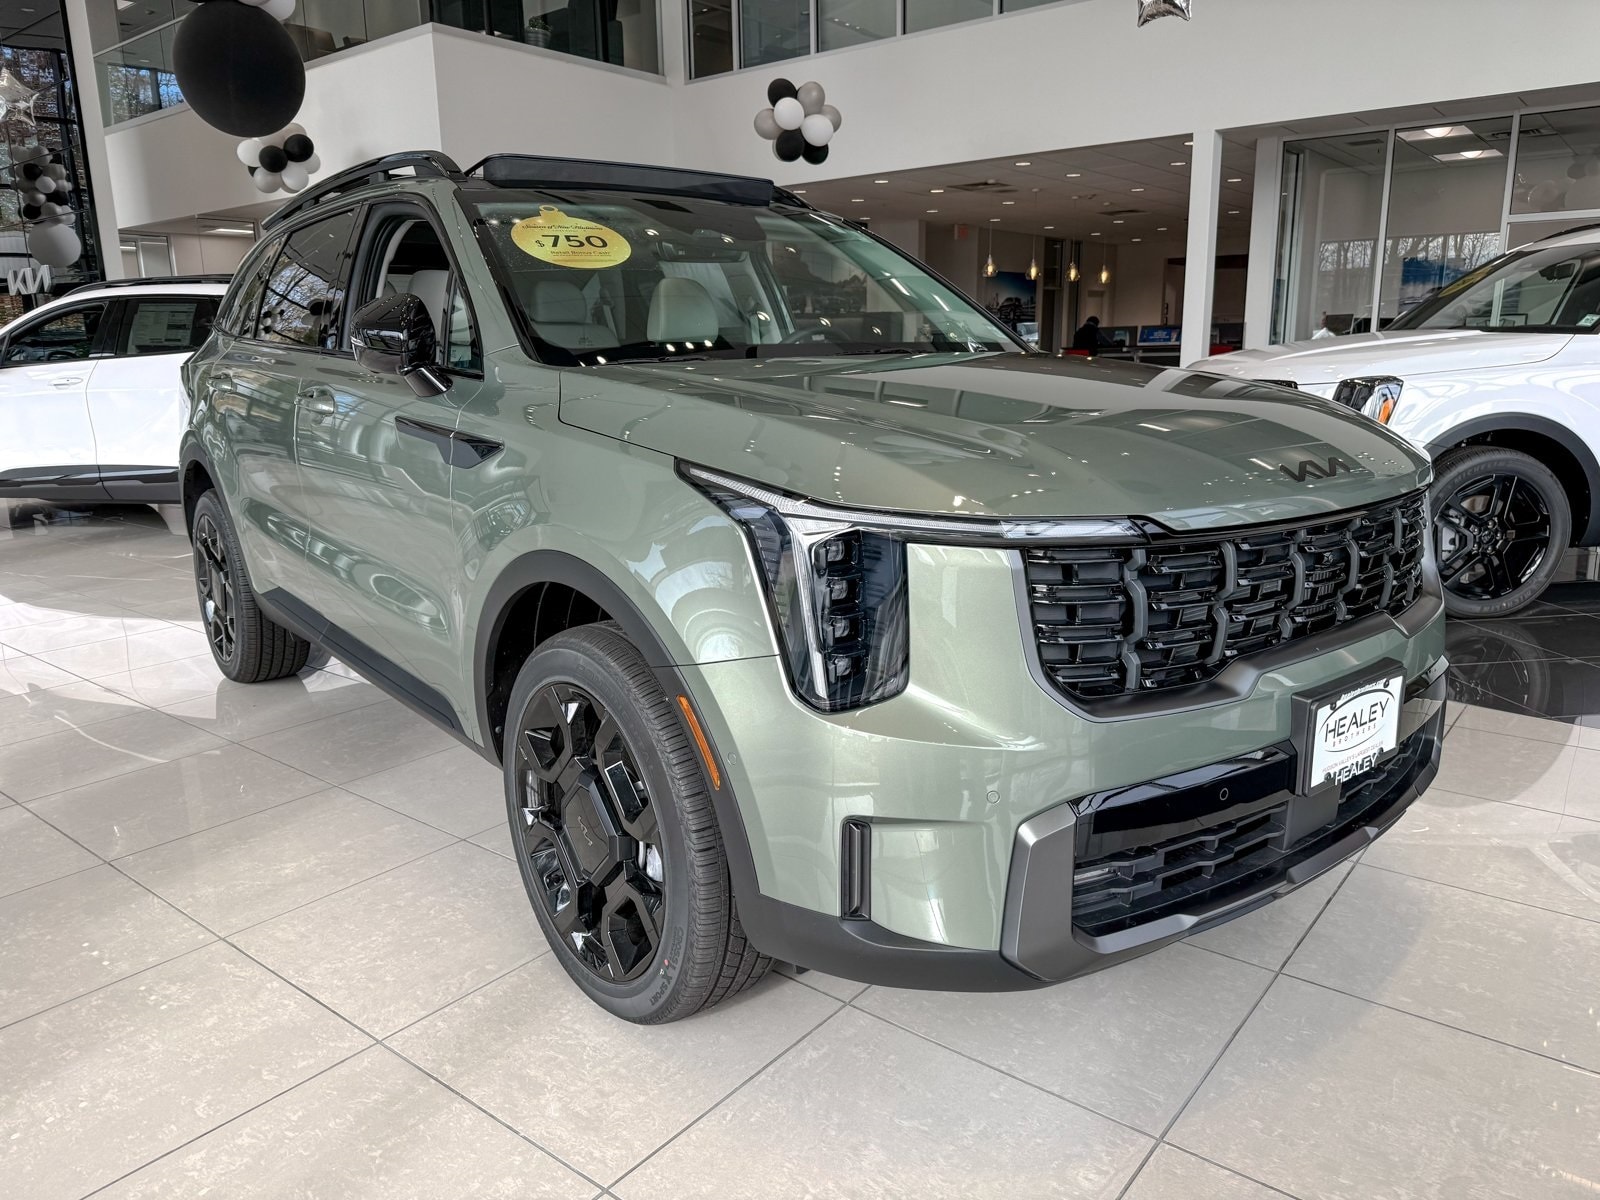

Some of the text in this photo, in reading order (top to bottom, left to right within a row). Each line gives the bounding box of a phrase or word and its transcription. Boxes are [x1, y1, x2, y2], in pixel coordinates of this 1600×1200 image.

[535, 234, 608, 248] $750
[1325, 697, 1390, 743] HEALEY
[1334, 753, 1378, 786] HEALEY
